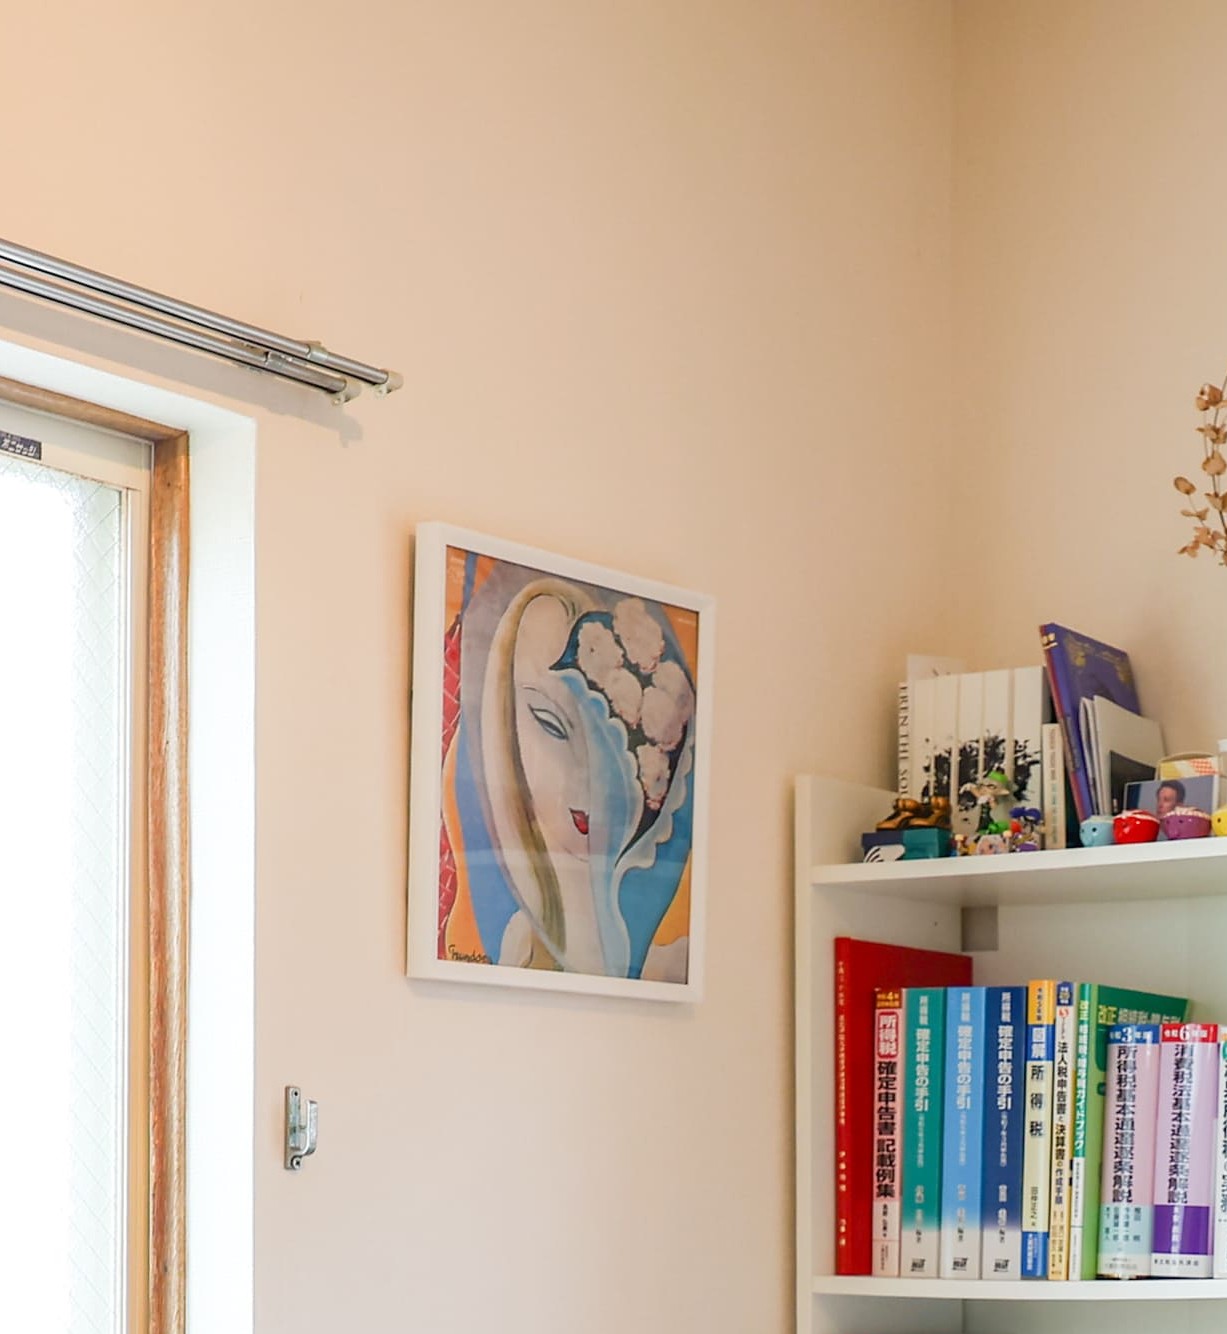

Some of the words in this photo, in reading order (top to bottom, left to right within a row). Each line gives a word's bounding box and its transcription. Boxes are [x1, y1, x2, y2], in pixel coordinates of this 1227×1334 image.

[878, 1014, 897, 1056] 所得税
[914, 1028, 931, 1111] 確定申告の手引
[956, 1025, 973, 1110] 確定申告の手引
[997, 1025, 1014, 1110] 確定申告の手引
[1029, 1065, 1045, 1137] 所得税
